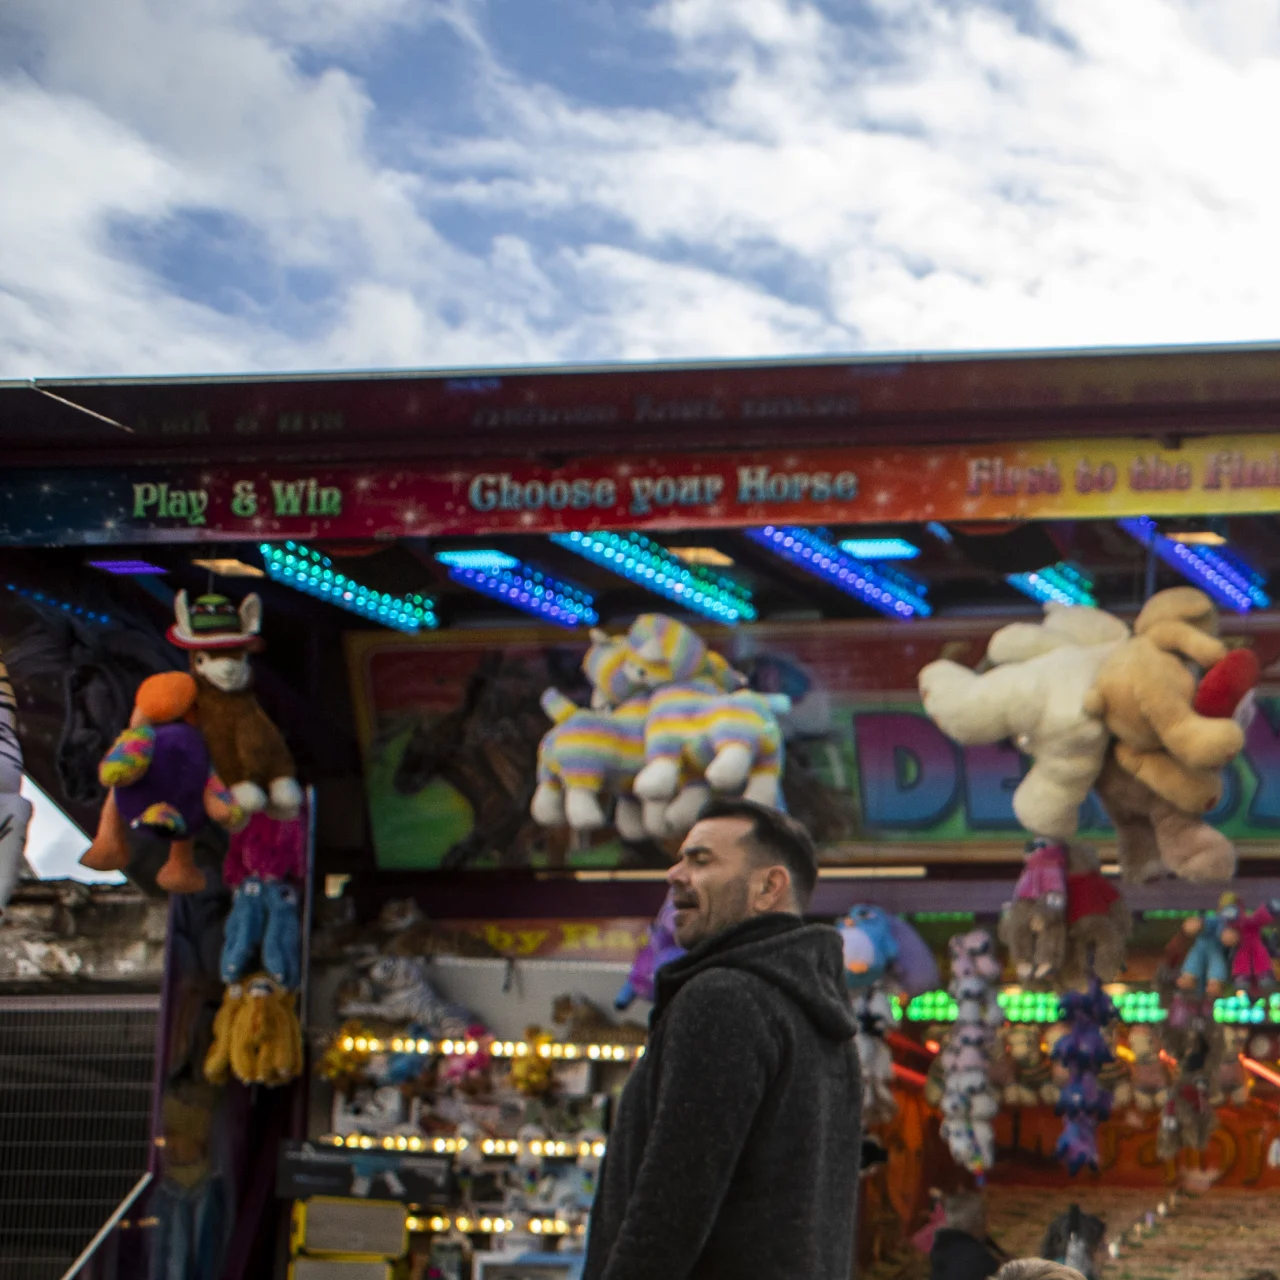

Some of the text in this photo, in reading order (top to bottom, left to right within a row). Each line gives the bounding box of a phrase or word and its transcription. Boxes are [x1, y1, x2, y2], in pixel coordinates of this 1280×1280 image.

[468, 466, 858, 515] Choose your Horse
[966, 457, 1061, 497] First
[1074, 457, 1116, 492] to
[1128, 454, 1192, 491] the
[132, 478, 342, 526] Play & Win
